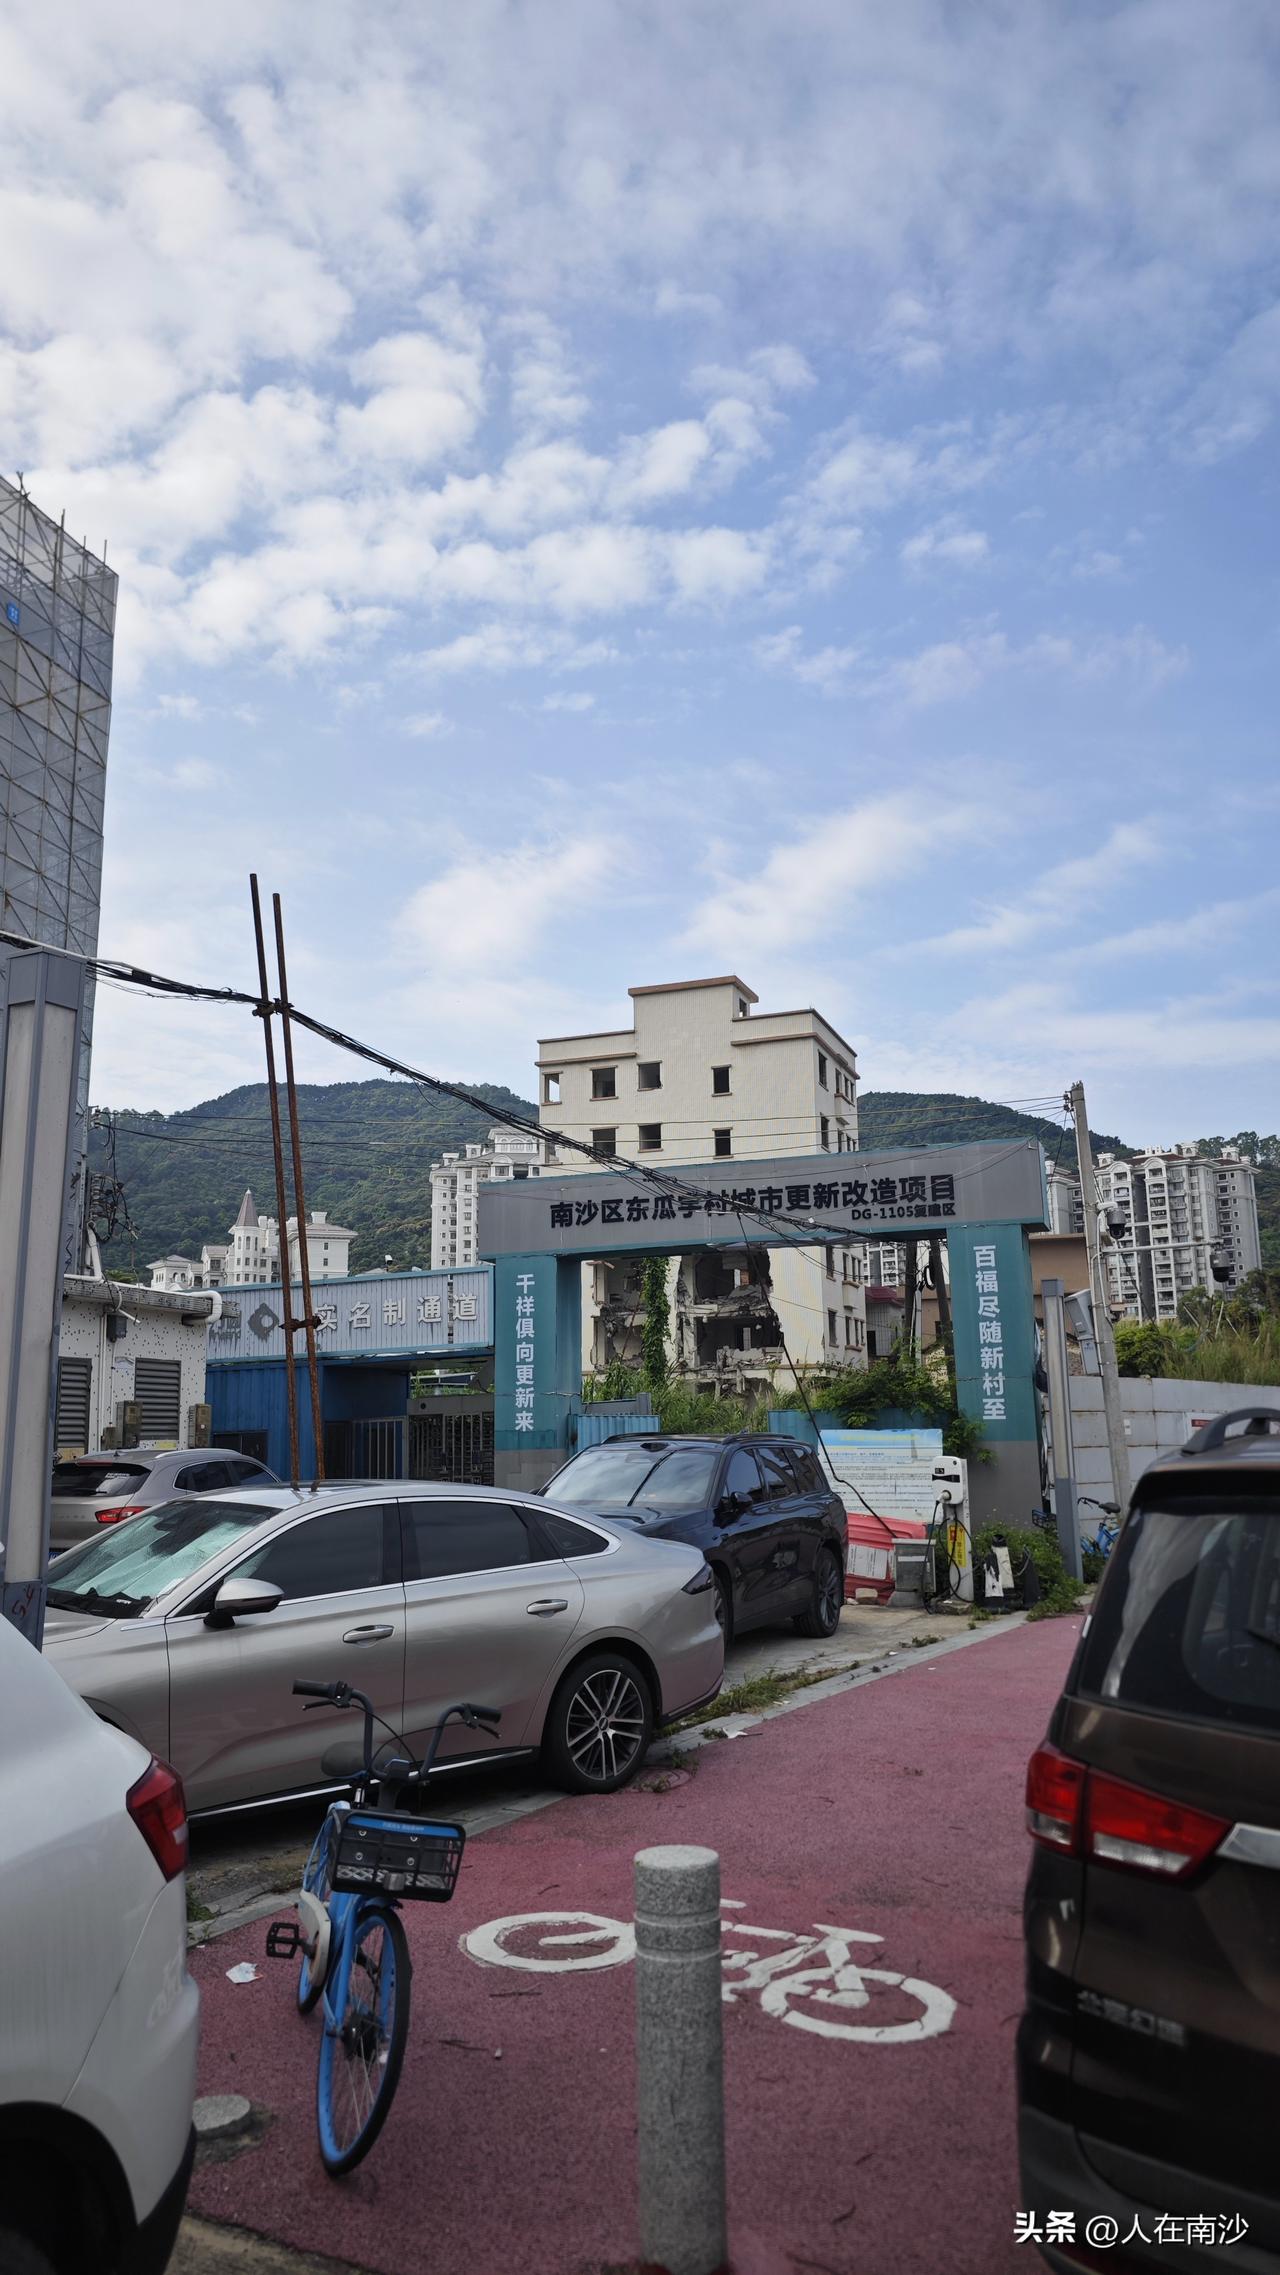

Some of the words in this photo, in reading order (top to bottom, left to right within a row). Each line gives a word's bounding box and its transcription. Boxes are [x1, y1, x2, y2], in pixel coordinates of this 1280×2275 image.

[313, 1292, 477, 1331] 实名制通道
[973, 1245, 1006, 1420] 百福尽随新村至
